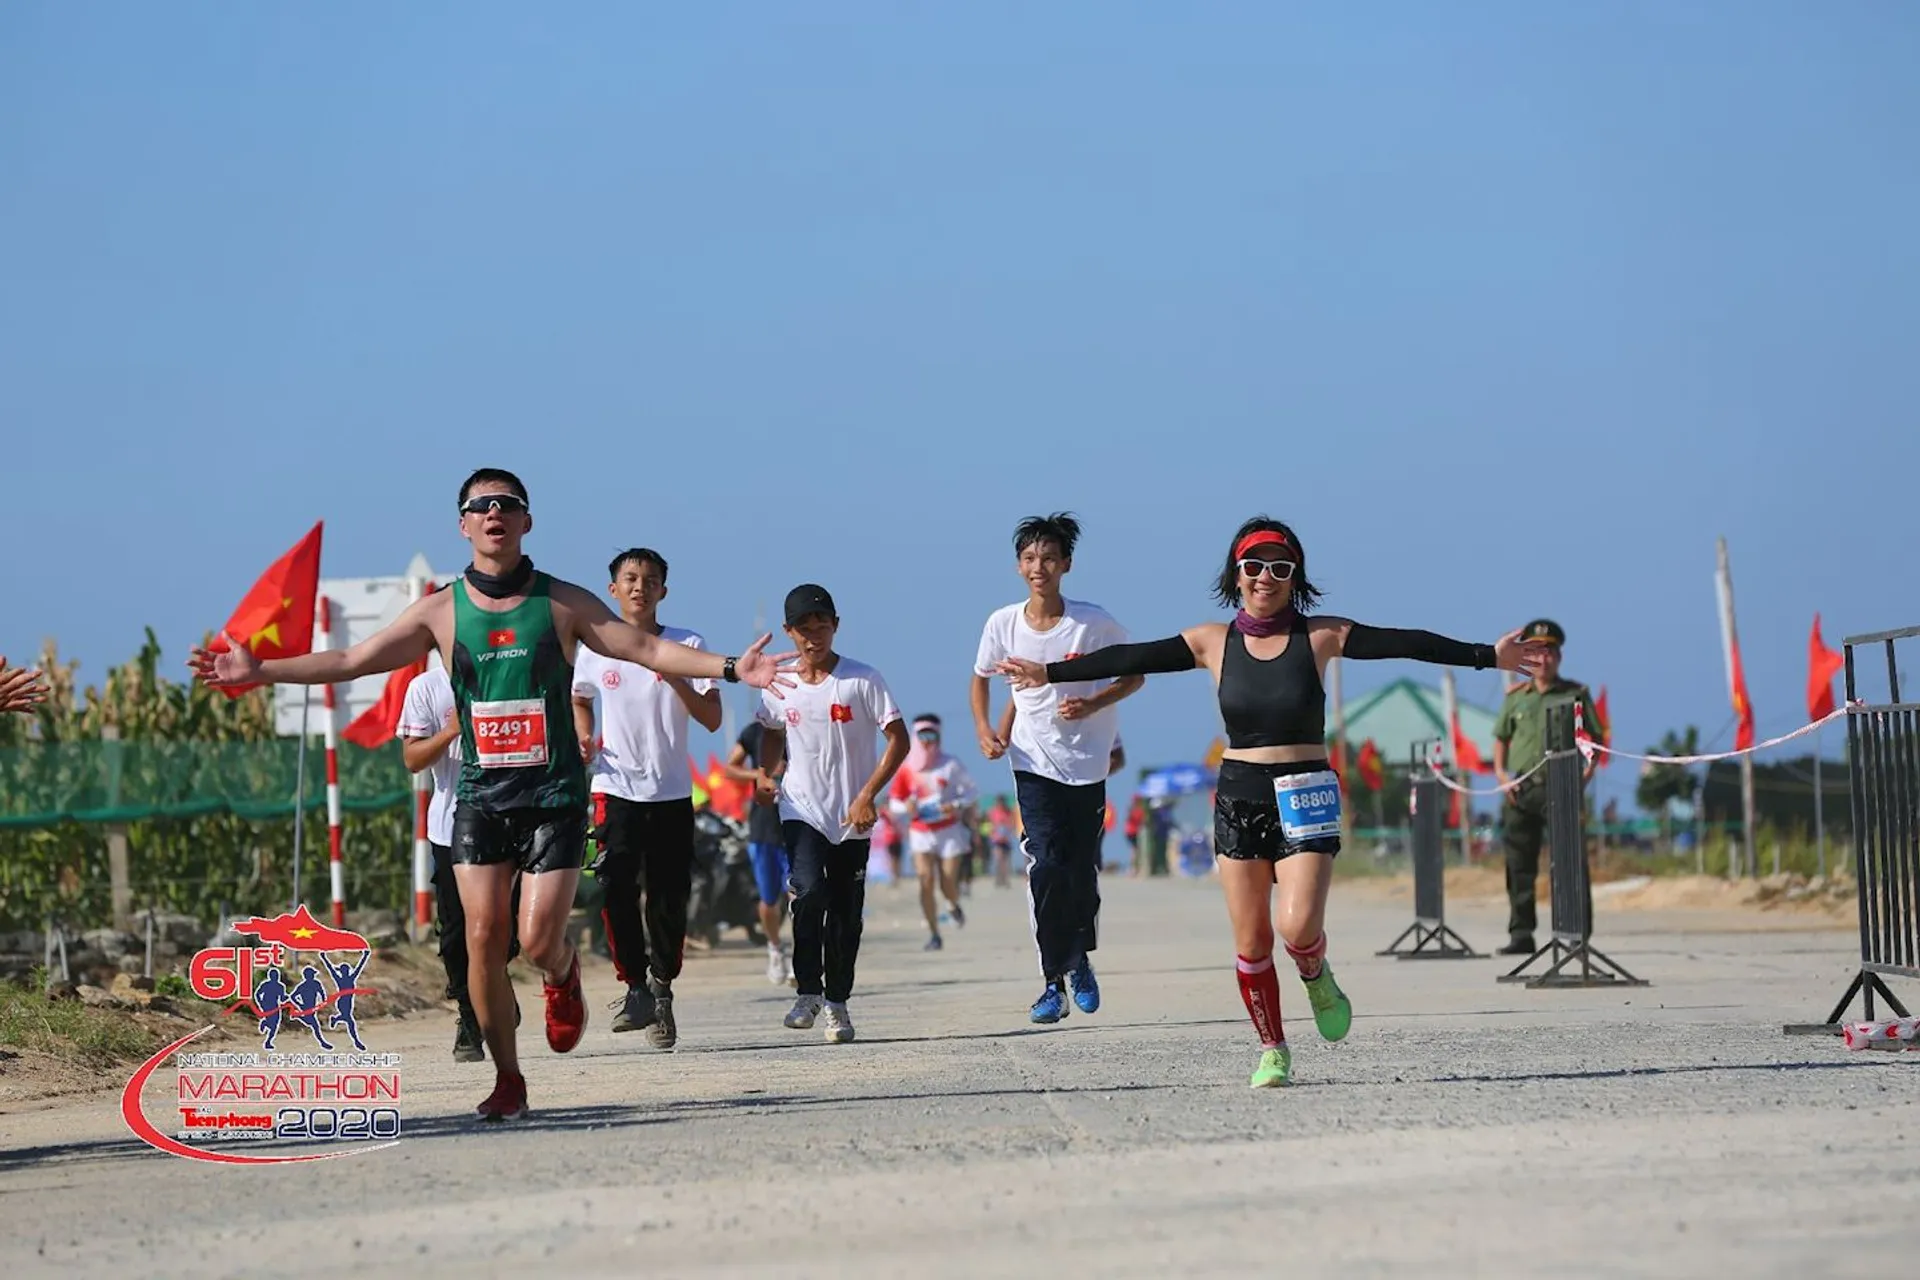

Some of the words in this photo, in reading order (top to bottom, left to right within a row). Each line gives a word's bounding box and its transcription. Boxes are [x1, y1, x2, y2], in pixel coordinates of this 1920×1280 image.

[476, 652, 497, 663] VP
[497, 648, 528, 660] IRON
[478, 719, 531, 738] 82491
[1289, 789, 1336, 811] 88800
